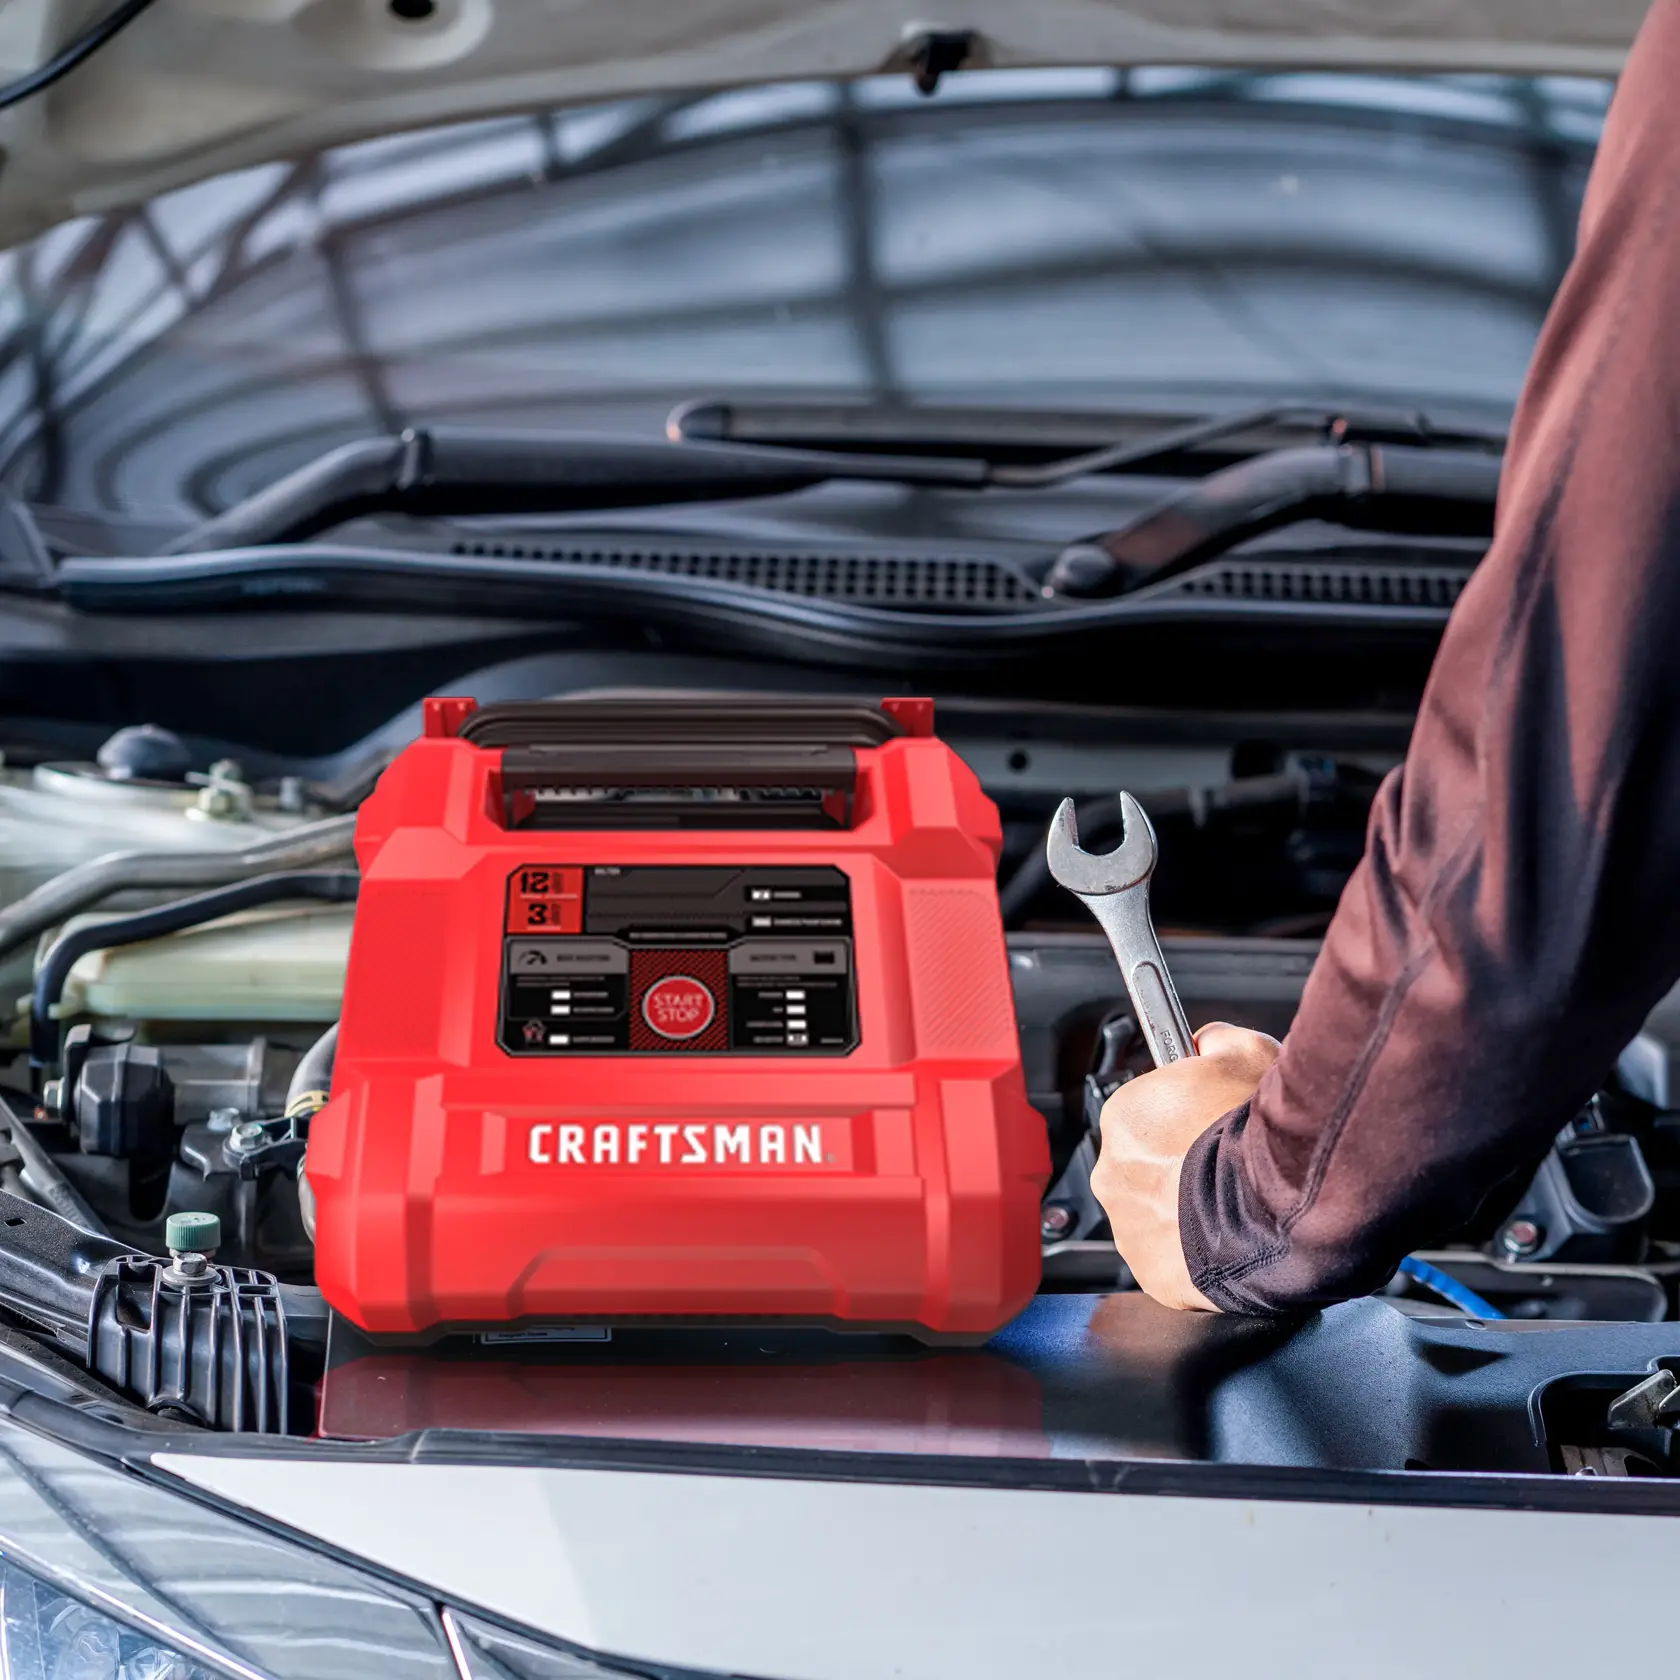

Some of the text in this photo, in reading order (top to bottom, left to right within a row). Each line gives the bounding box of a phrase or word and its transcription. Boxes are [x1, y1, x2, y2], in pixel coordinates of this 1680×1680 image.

[521, 872, 549, 894] 12
[527, 903, 547, 925] 3
[652, 993, 703, 1009] START
[657, 1008, 700, 1023] STOP
[528, 1124, 822, 1163] CRAFTSMAN
